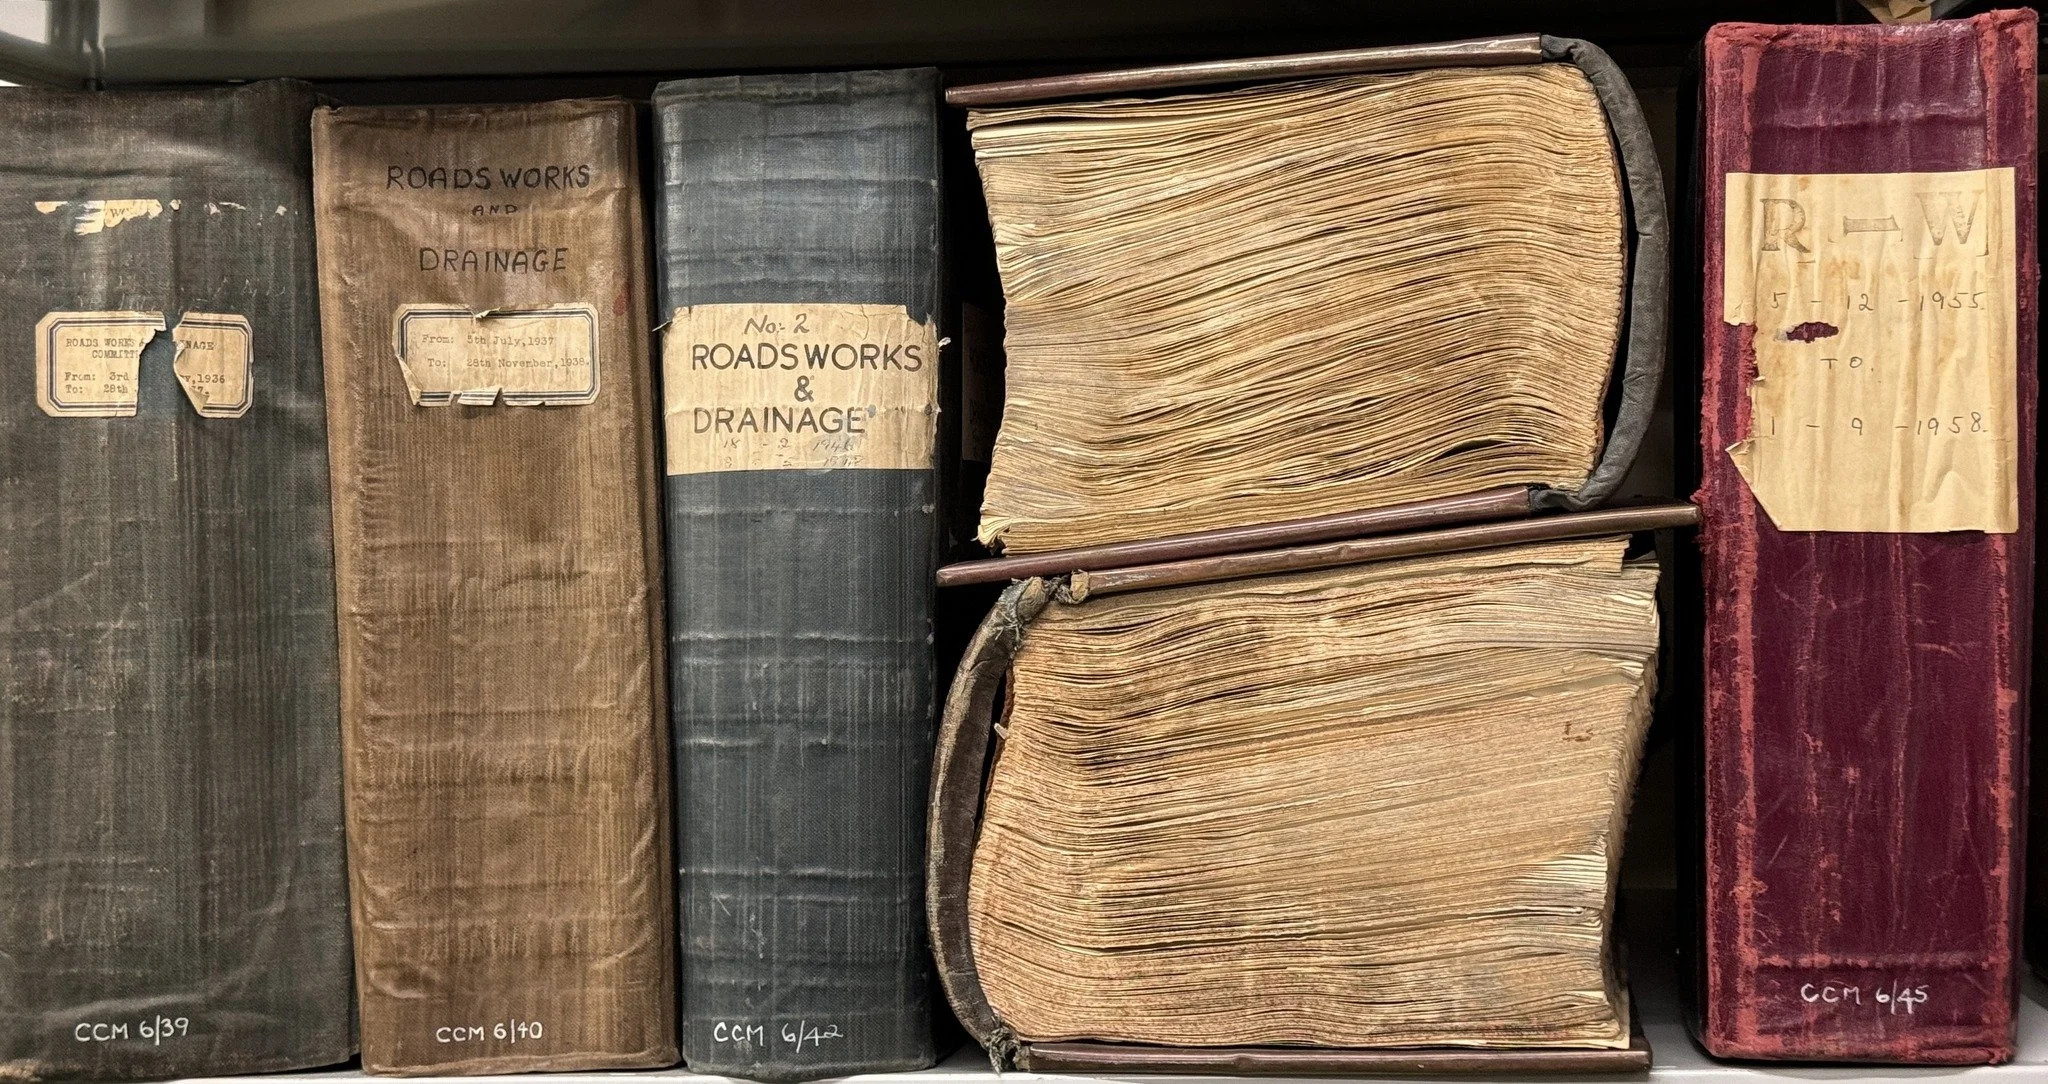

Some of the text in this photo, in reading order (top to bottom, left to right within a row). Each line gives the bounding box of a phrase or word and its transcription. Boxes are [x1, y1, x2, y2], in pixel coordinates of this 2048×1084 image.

[386, 164, 591, 191] ROADS WORKS
[472, 204, 520, 216] AND
[1759, 198, 1813, 253] R
[1913, 189, 1985, 246] W
[419, 247, 568, 274] DRAINAGE
[1771, 292, 1787, 309] 5
[795, 313, 810, 334] 2
[66, 337, 99, 348] ROADS
[104, 337, 135, 348] WORKS
[421, 334, 455, 344] From:
[467, 335, 487, 345] 5th
[427, 358, 447, 368] To:
[466, 358, 492, 368] 28th
[692, 343, 923, 372] ROADS WORKS
[65, 384, 83, 394] To:
[103, 383, 128, 394] 28th
[109, 371, 129, 381] 3rd
[794, 374, 815, 402] &
[693, 406, 866, 433] DRAINAGE
[1850, 417, 1864, 436] 9
[1801, 978, 1929, 1015] CCM 6/45
[75, 1014, 190, 1046] CCM 6/39
[436, 1018, 543, 1044] CCM 6/40
[713, 1020, 844, 1054] CCM 6/42
